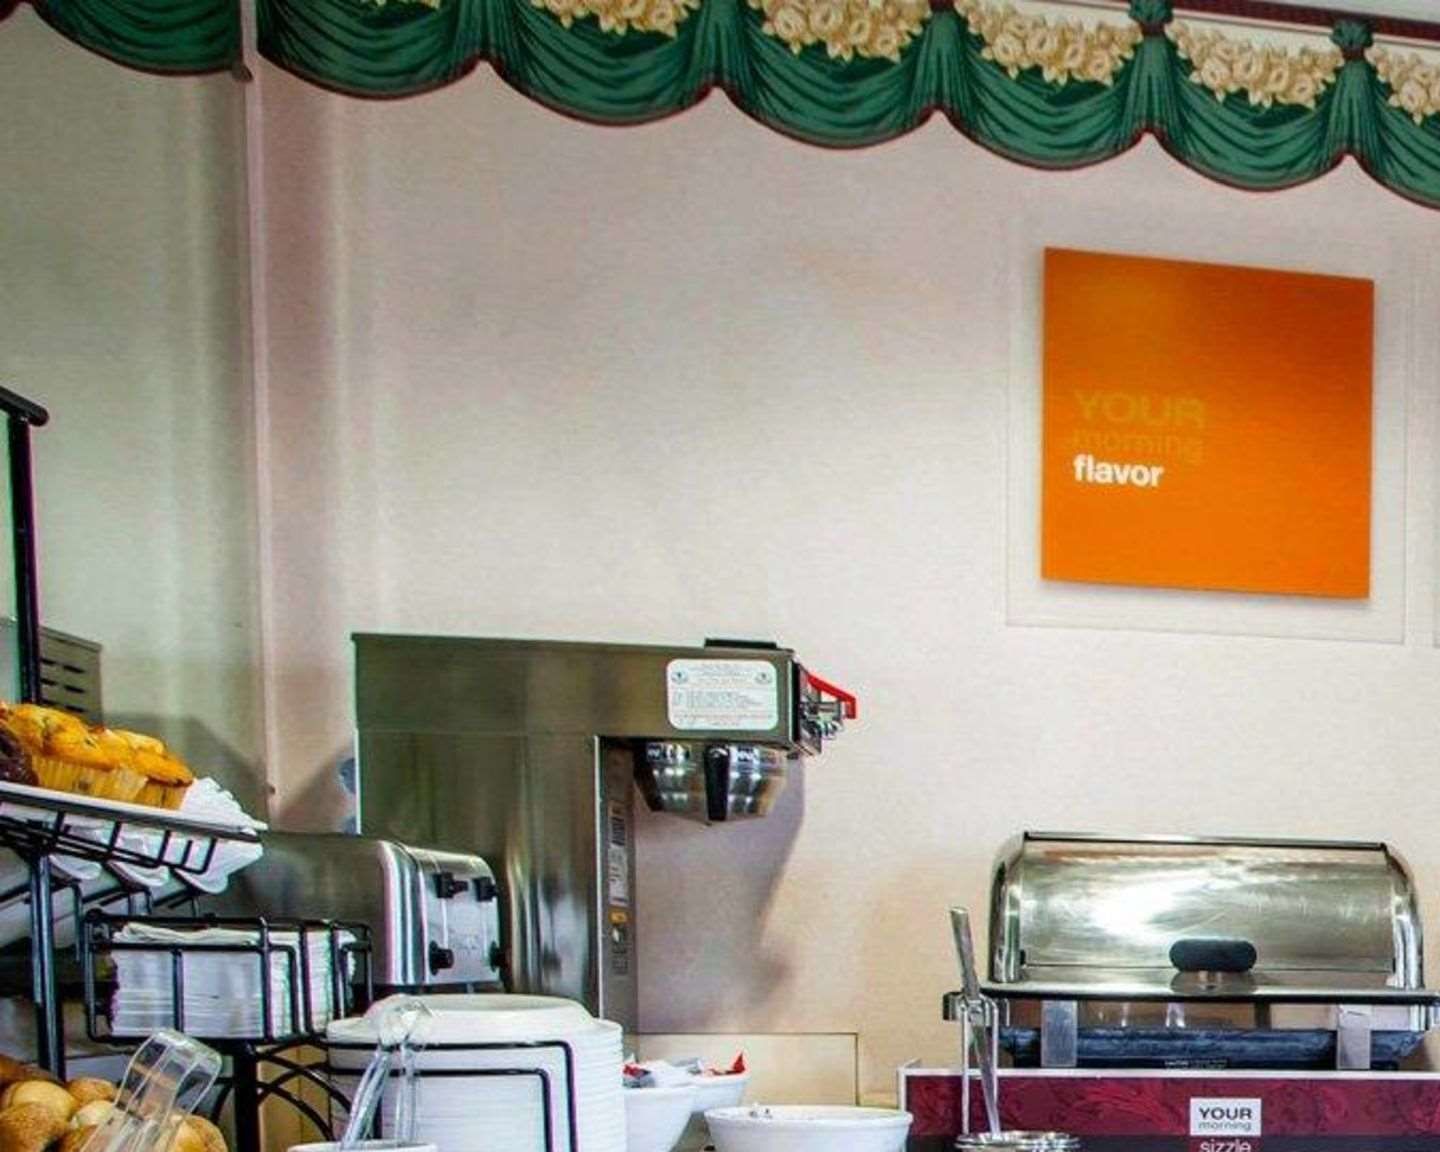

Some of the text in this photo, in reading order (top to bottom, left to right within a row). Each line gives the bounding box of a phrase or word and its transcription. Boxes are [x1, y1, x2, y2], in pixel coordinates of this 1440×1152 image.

[1075, 391, 1206, 428] YOUR
[1074, 453, 1164, 486] flavor
[1198, 1106, 1253, 1120] YOUR
[1198, 1119, 1252, 1132] morning
